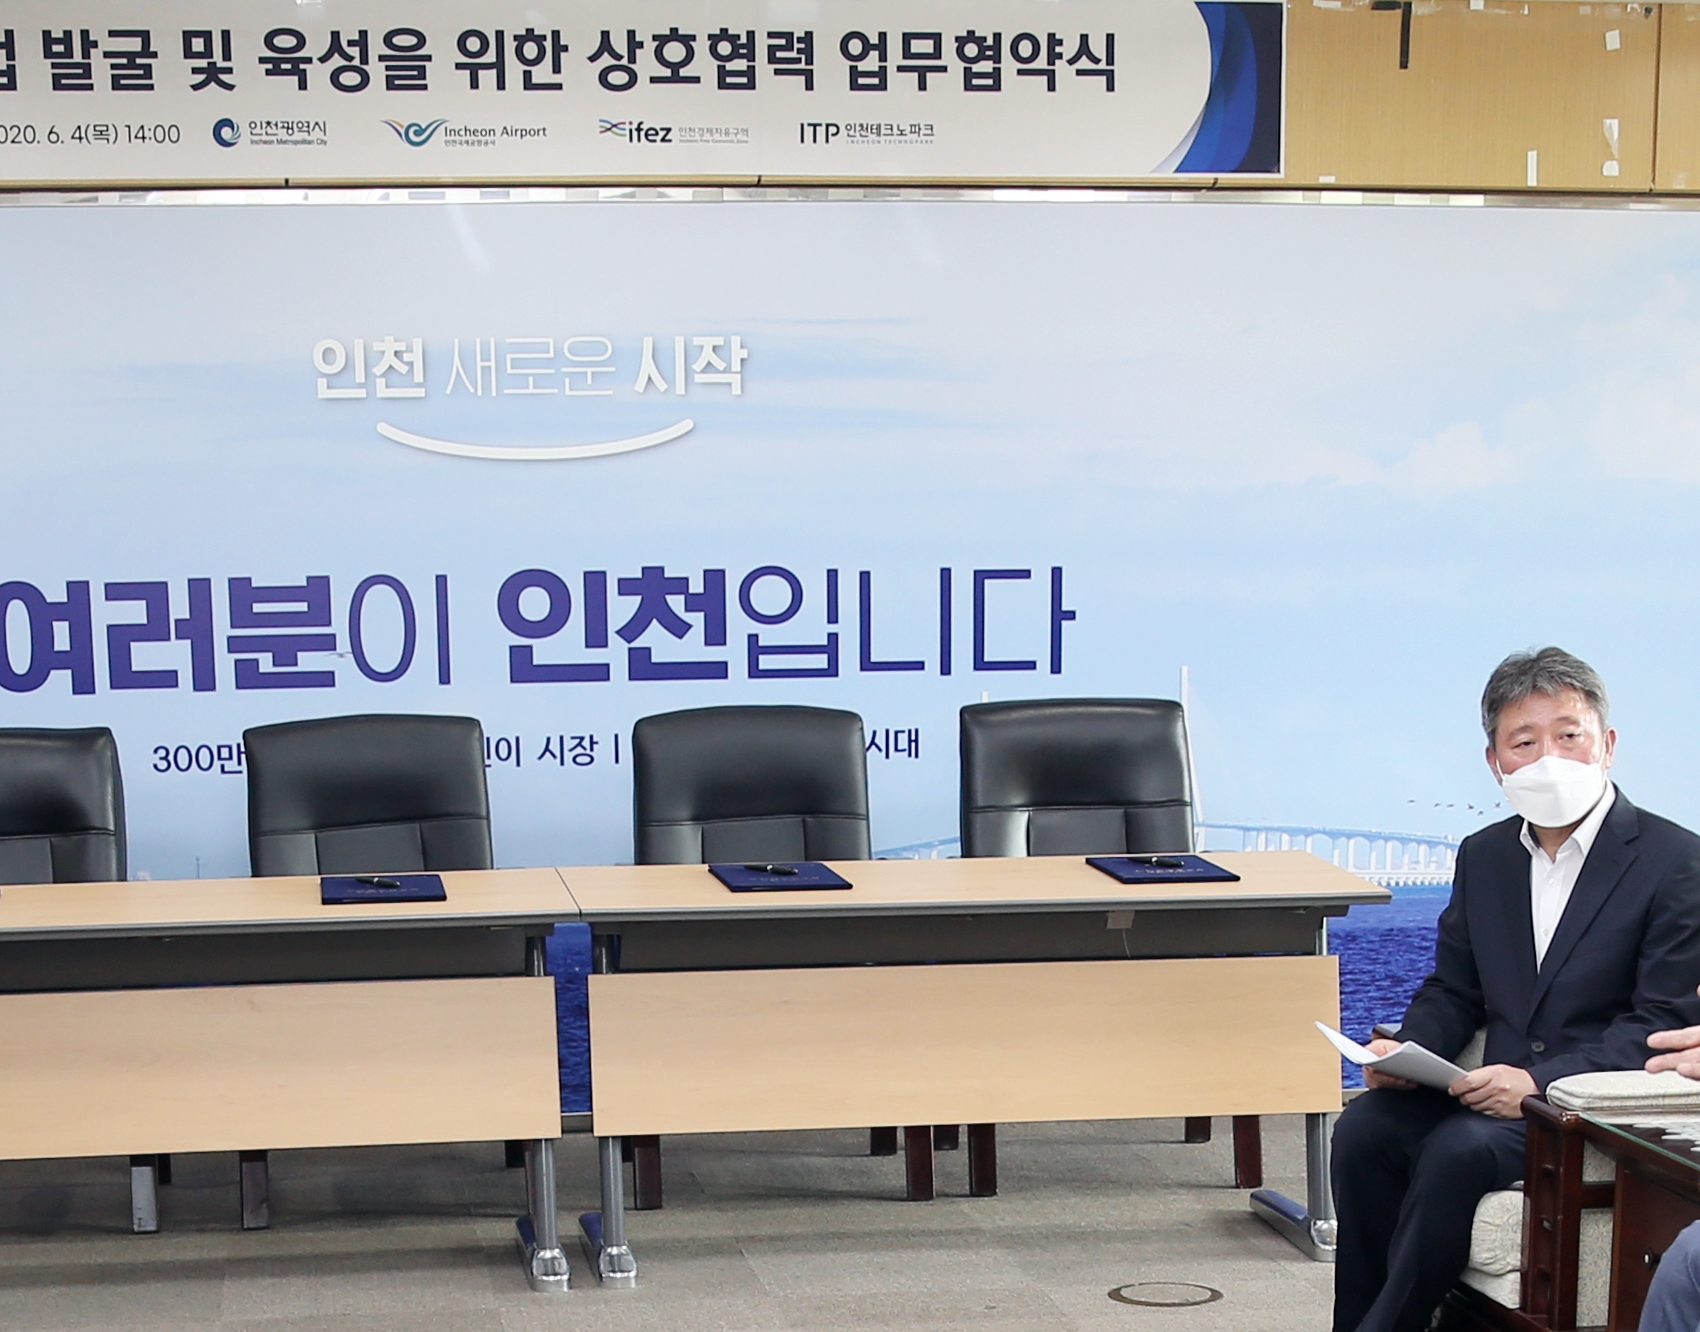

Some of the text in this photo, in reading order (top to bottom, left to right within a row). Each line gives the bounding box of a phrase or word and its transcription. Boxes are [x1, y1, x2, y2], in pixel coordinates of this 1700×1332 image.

[41, 28, 159, 92] 발굴
[181, 28, 238, 92] 및
[257, 27, 433, 93] 육성을
[454, 27, 570, 92] 위한
[585, 27, 816, 93] 상호협력
[838, 29, 1116, 93] 업무협약식
[46, 124, 65, 145] 6.
[70, 122, 119, 146] 4(목)
[123, 124, 181, 145] 14:00
[248, 120, 327, 137] 인천광역시
[444, 125, 548, 140] Incheon Airport
[627, 121, 673, 144] ifez
[799, 122, 841, 144] ITP
[844, 122, 935, 138] 인천테크노파크
[312, 334, 749, 400] 인천 새로운 시작
[496, 564, 1077, 684] 인천입니다
[152, 742, 246, 775] 300만
[536, 733, 600, 767] 시장
